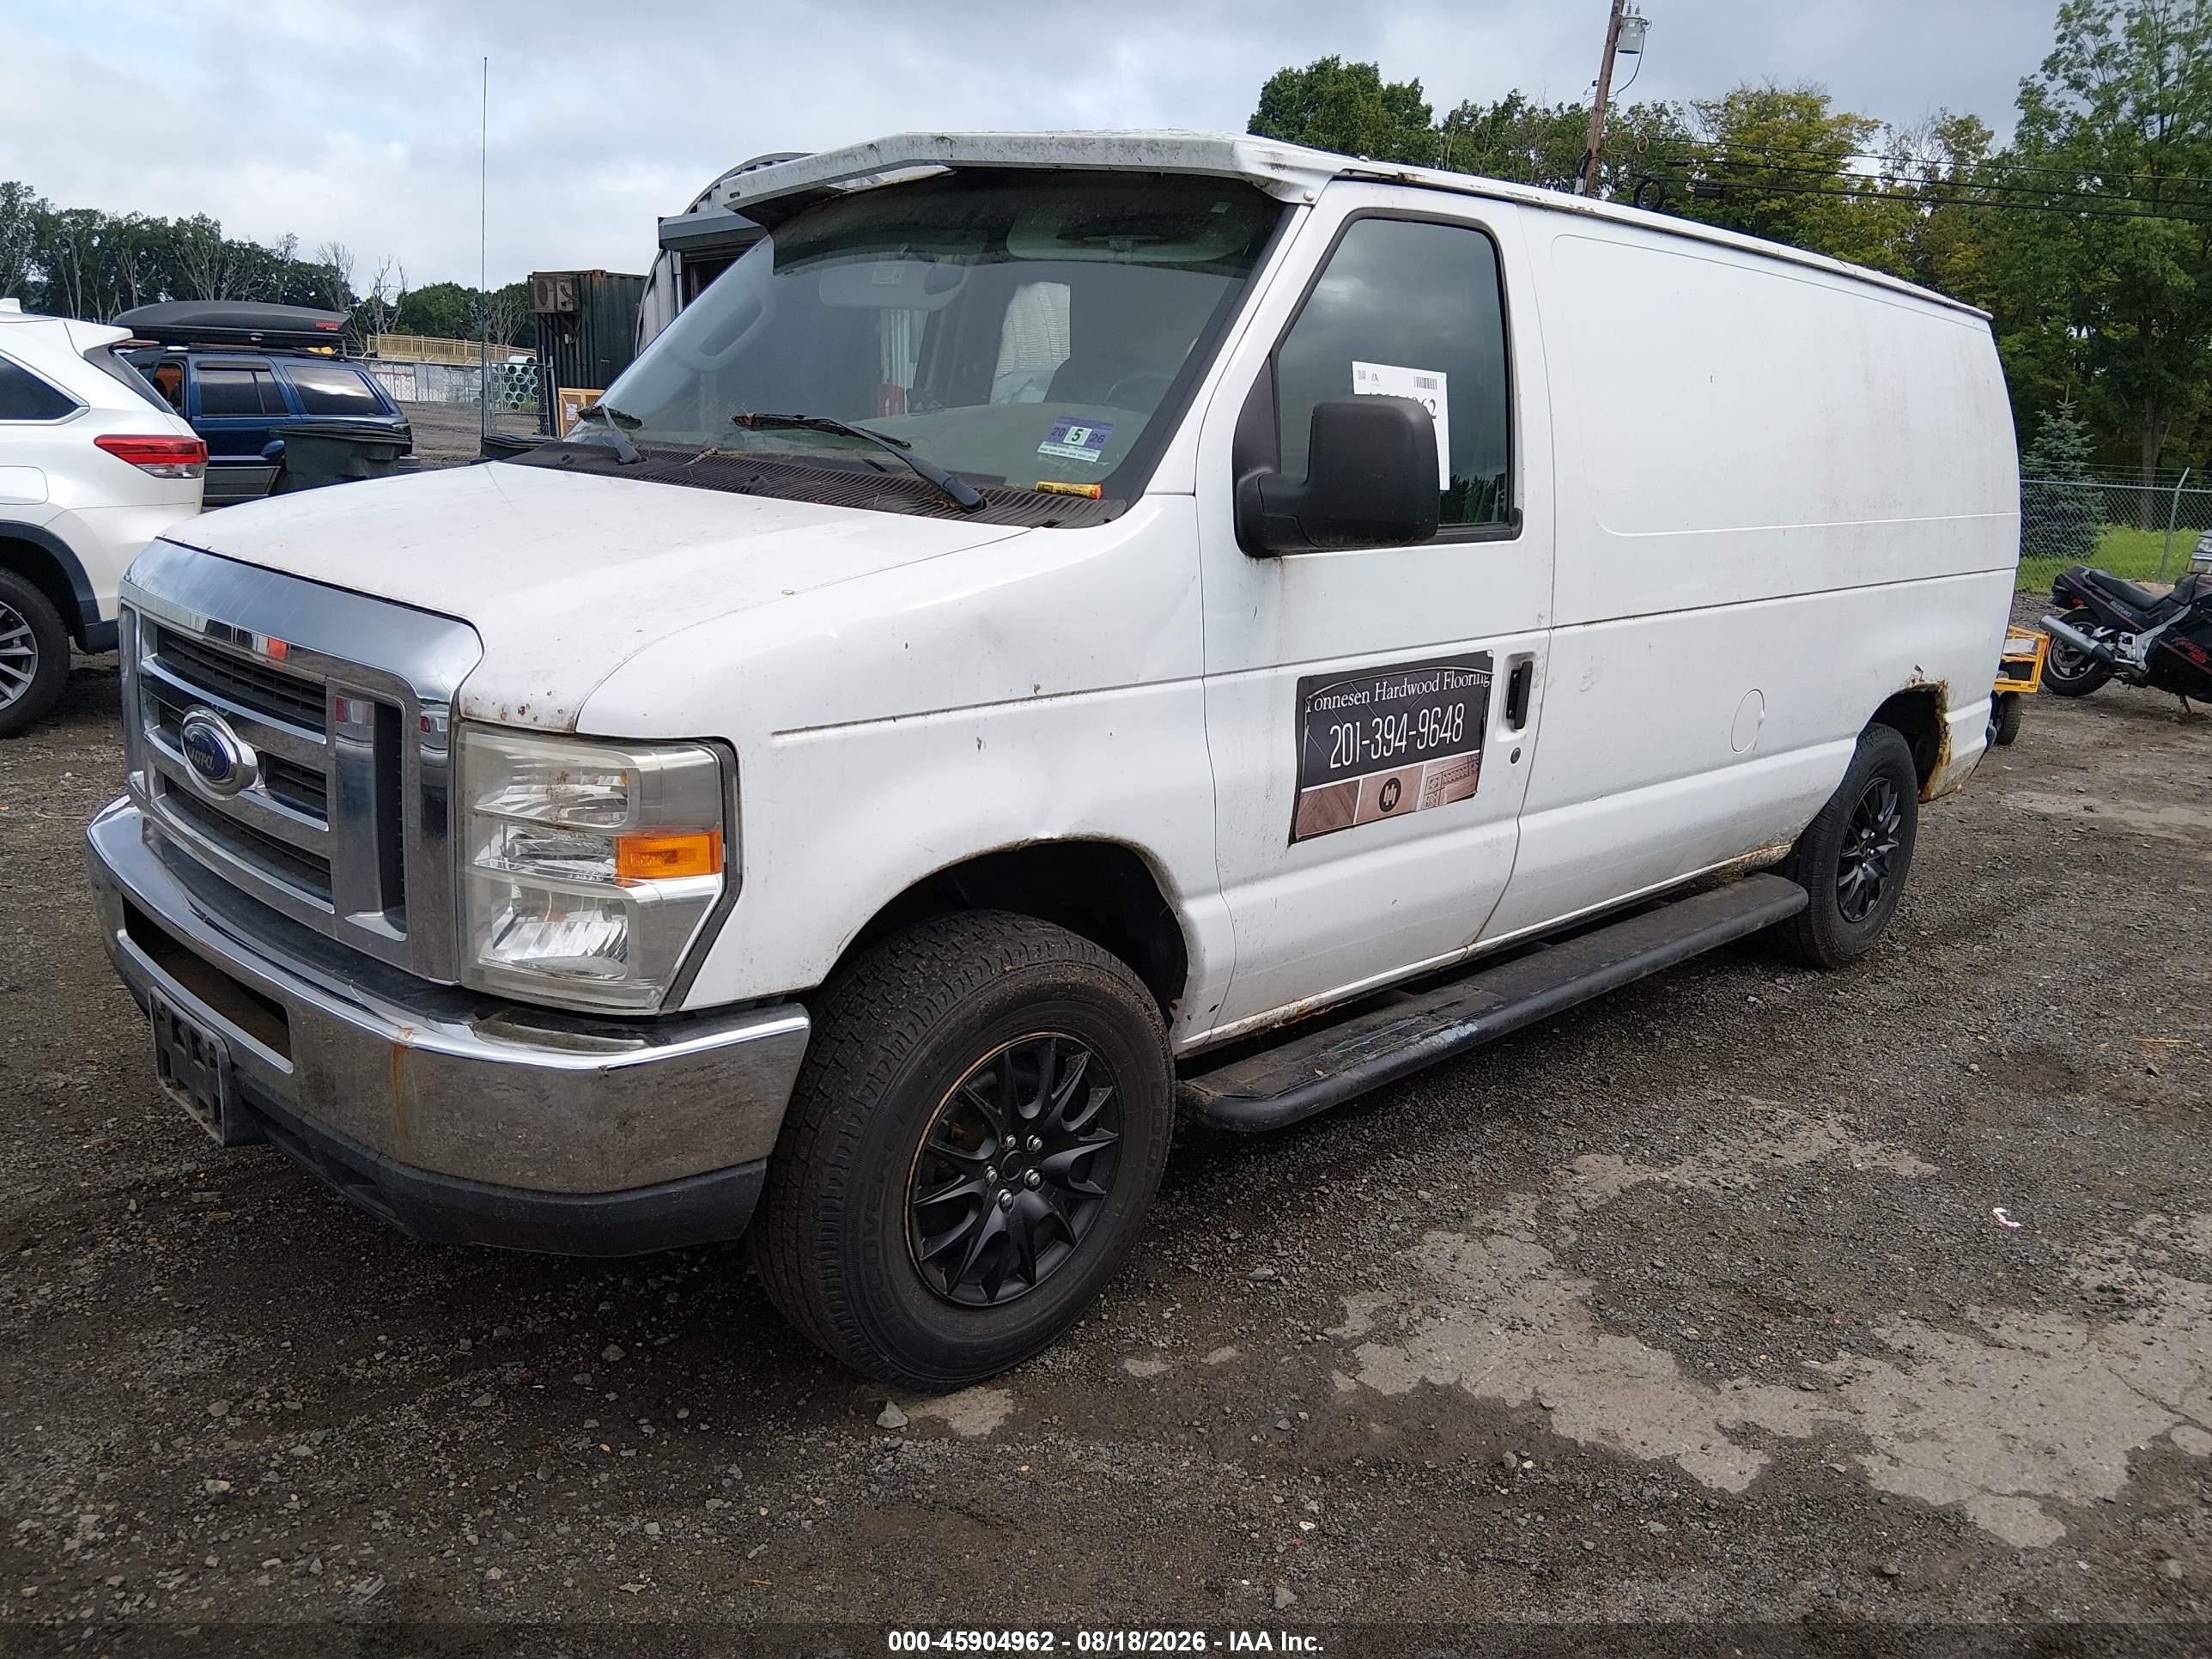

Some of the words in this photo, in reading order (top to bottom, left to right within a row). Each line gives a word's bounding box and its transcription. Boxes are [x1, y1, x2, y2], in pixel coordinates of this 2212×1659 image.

[1050, 427, 1066, 438] 20
[1071, 428, 1084, 442] 5
[1090, 434, 1106, 444] 26
[1374, 672, 1440, 702] Hardwood
[1443, 670, 1490, 690] Flooring
[1329, 702, 1465, 769] 201-394-9648
